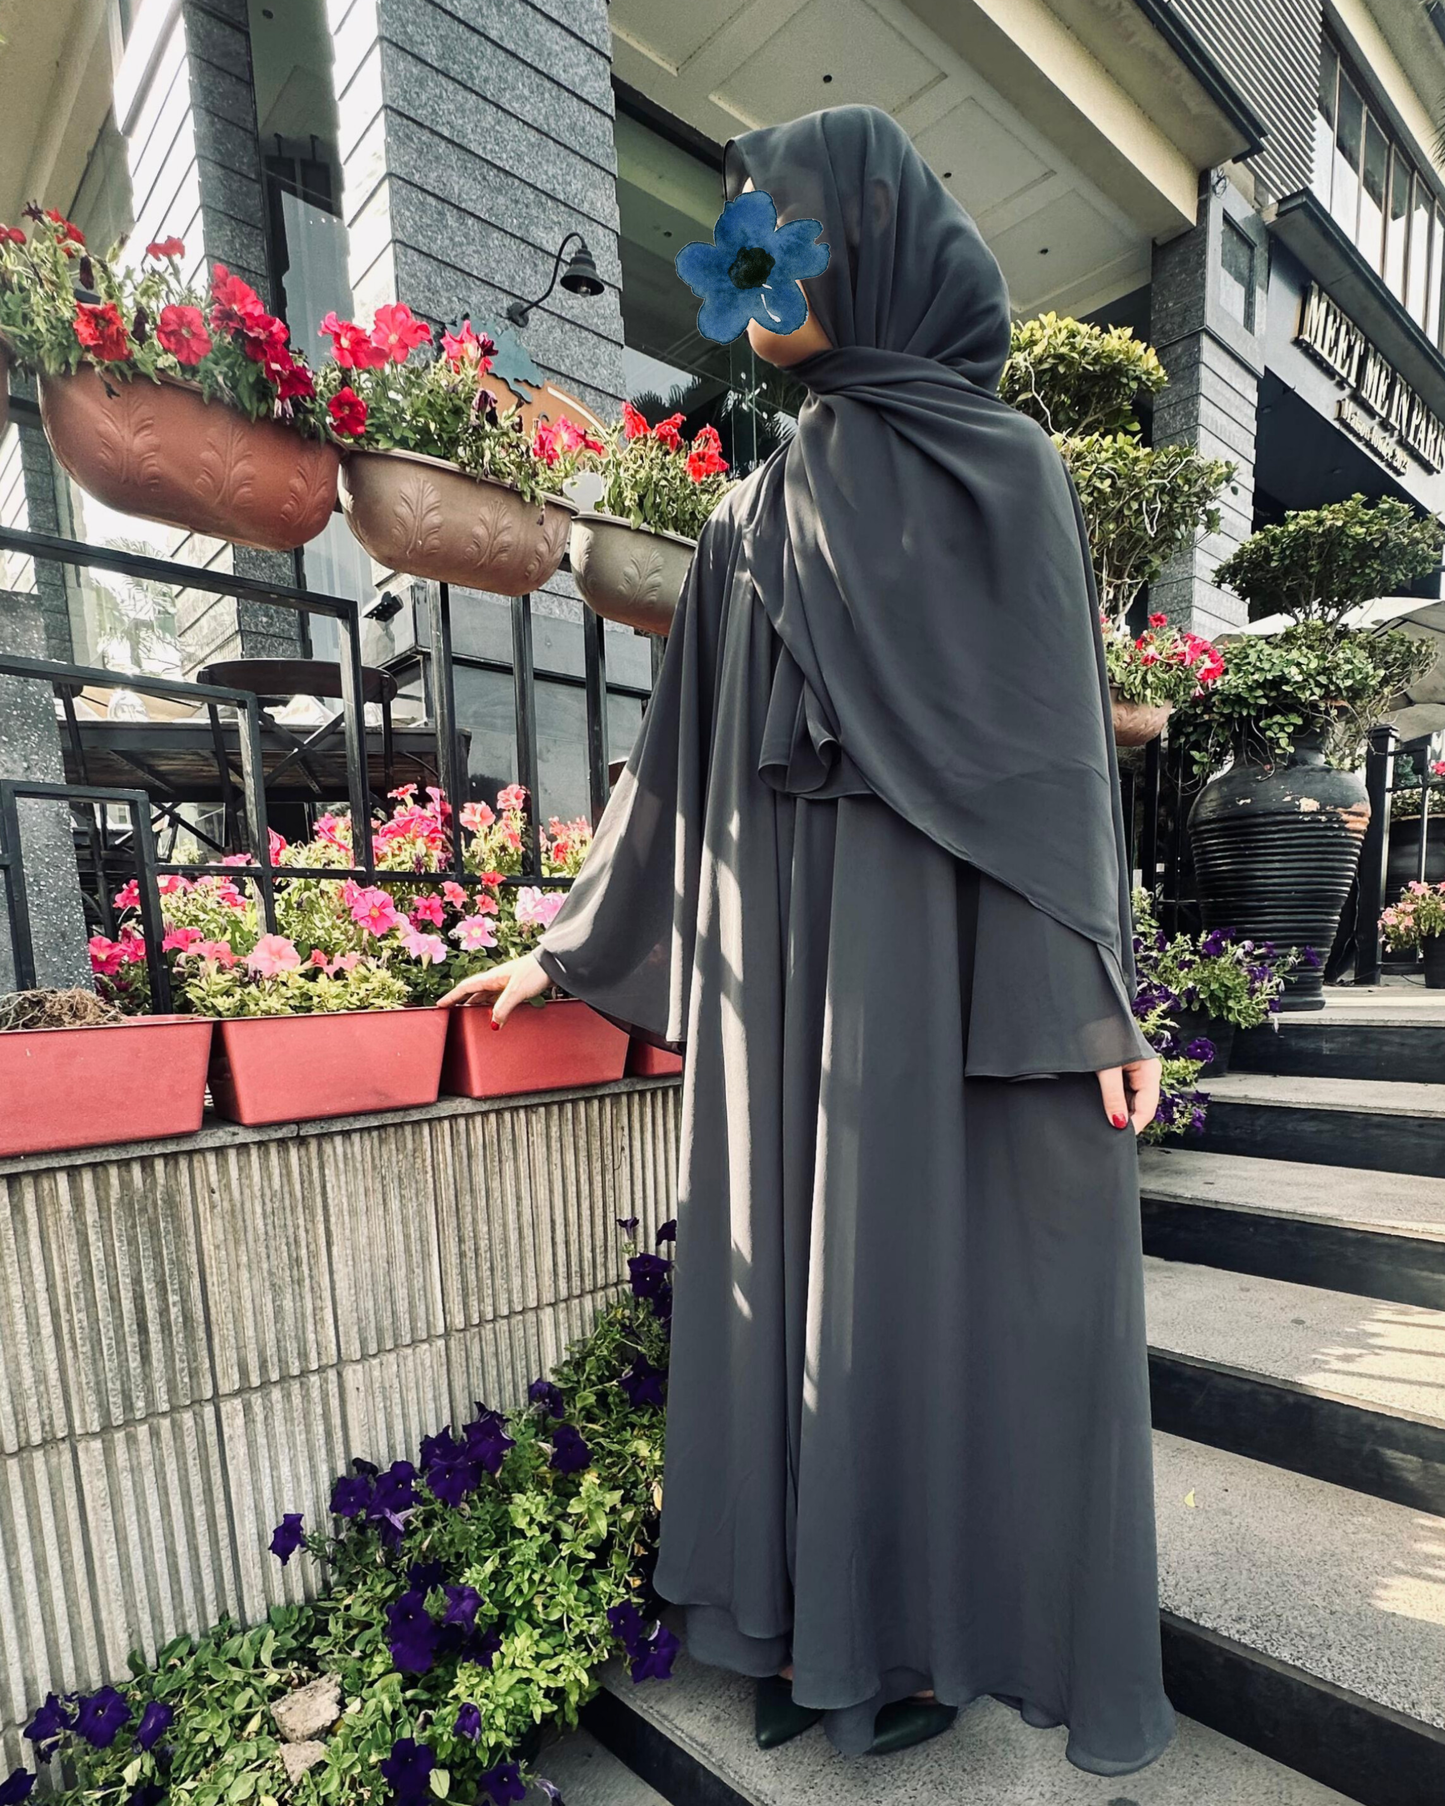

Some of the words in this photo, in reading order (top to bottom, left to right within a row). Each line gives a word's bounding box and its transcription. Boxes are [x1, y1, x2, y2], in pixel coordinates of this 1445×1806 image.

[1301, 280, 1365, 388] MEET
[1361, 342, 1391, 418] ME
[1389, 372, 1412, 440] IN
